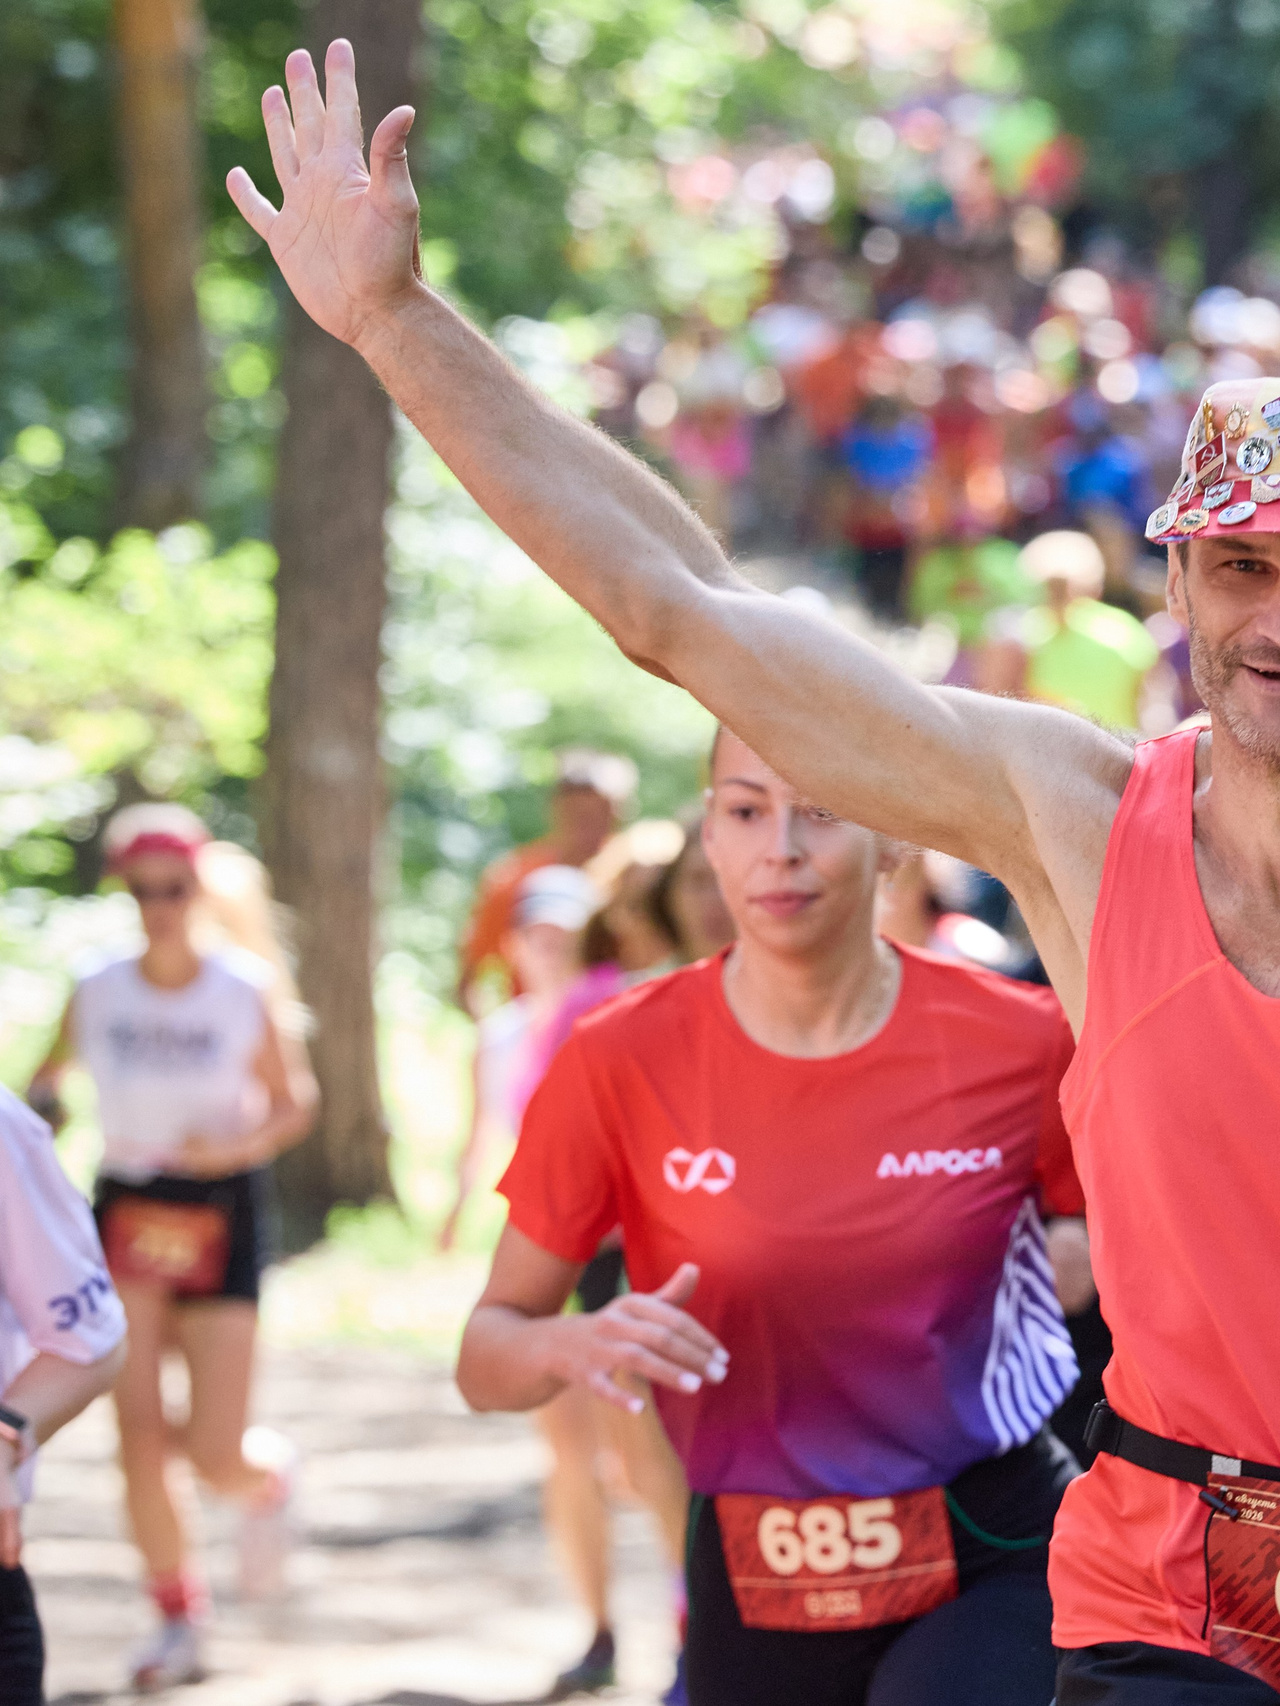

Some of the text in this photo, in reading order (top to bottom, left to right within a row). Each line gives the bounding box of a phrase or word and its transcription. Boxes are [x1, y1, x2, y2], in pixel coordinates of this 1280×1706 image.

[1225, 1491, 1278, 1510] 9 августа
[1240, 1508, 1264, 1522] 2026
[758, 1499, 903, 1576] 685
